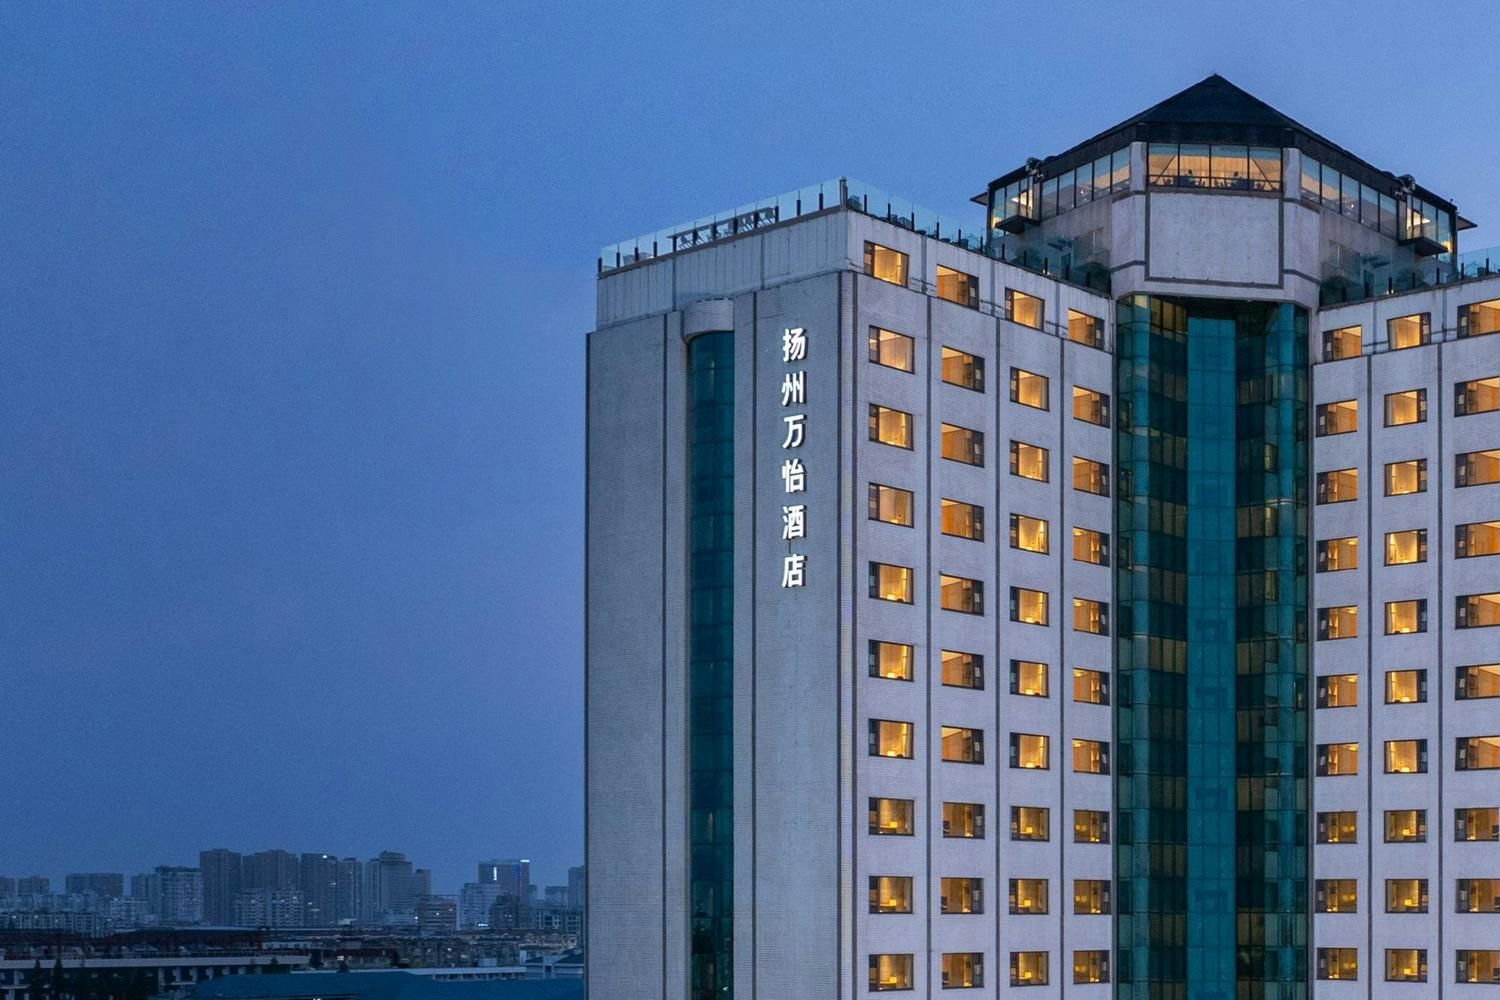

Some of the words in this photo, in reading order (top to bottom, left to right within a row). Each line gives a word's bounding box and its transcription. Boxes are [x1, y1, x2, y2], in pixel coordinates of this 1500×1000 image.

[781, 327, 806, 588] 扬州万怡酒店
